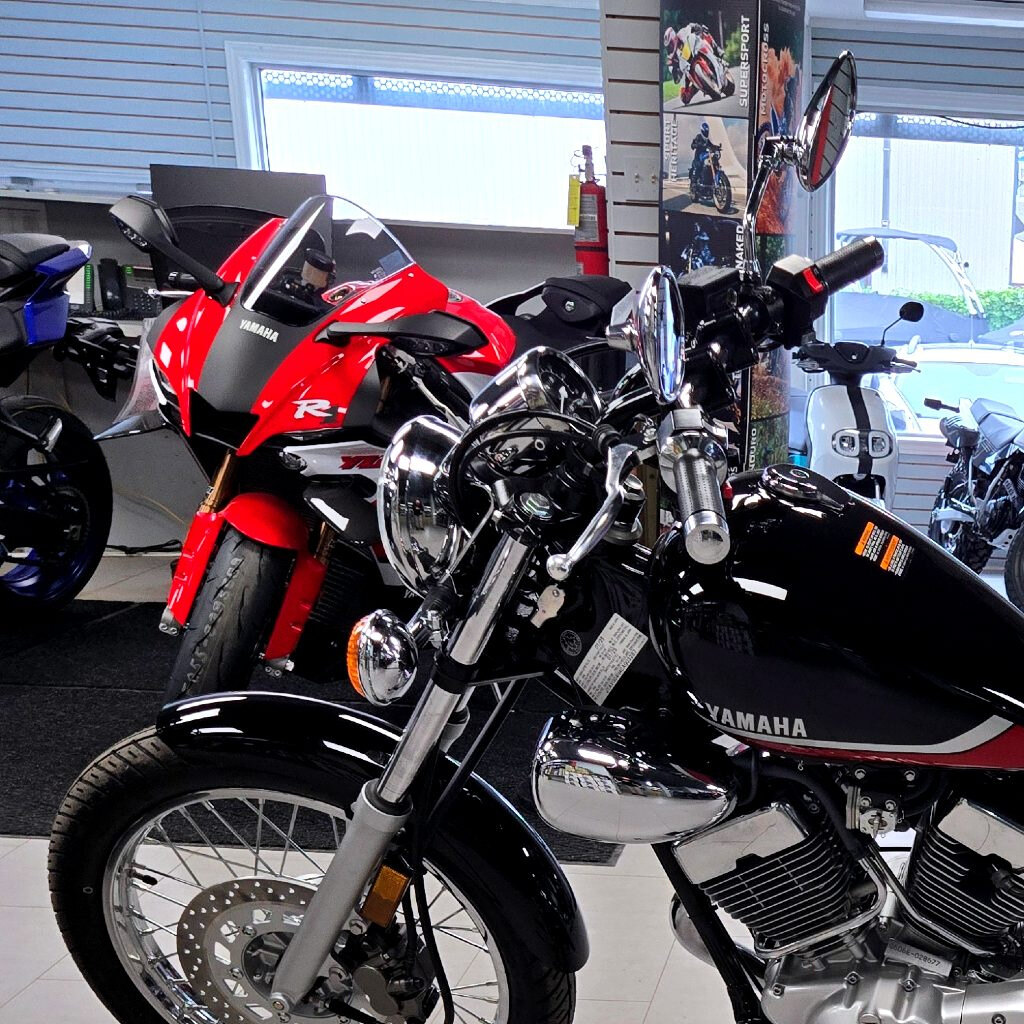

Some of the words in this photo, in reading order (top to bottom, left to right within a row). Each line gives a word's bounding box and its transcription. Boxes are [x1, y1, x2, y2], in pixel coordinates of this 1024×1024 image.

[740, 15, 750, 107] SUPERSPORT
[760, 22, 770, 116] MOTOCROSS
[735, 225, 744, 270] NAKED
[239, 319, 279, 343] YAMAHA
[705, 702, 808, 737] YAMAHA
